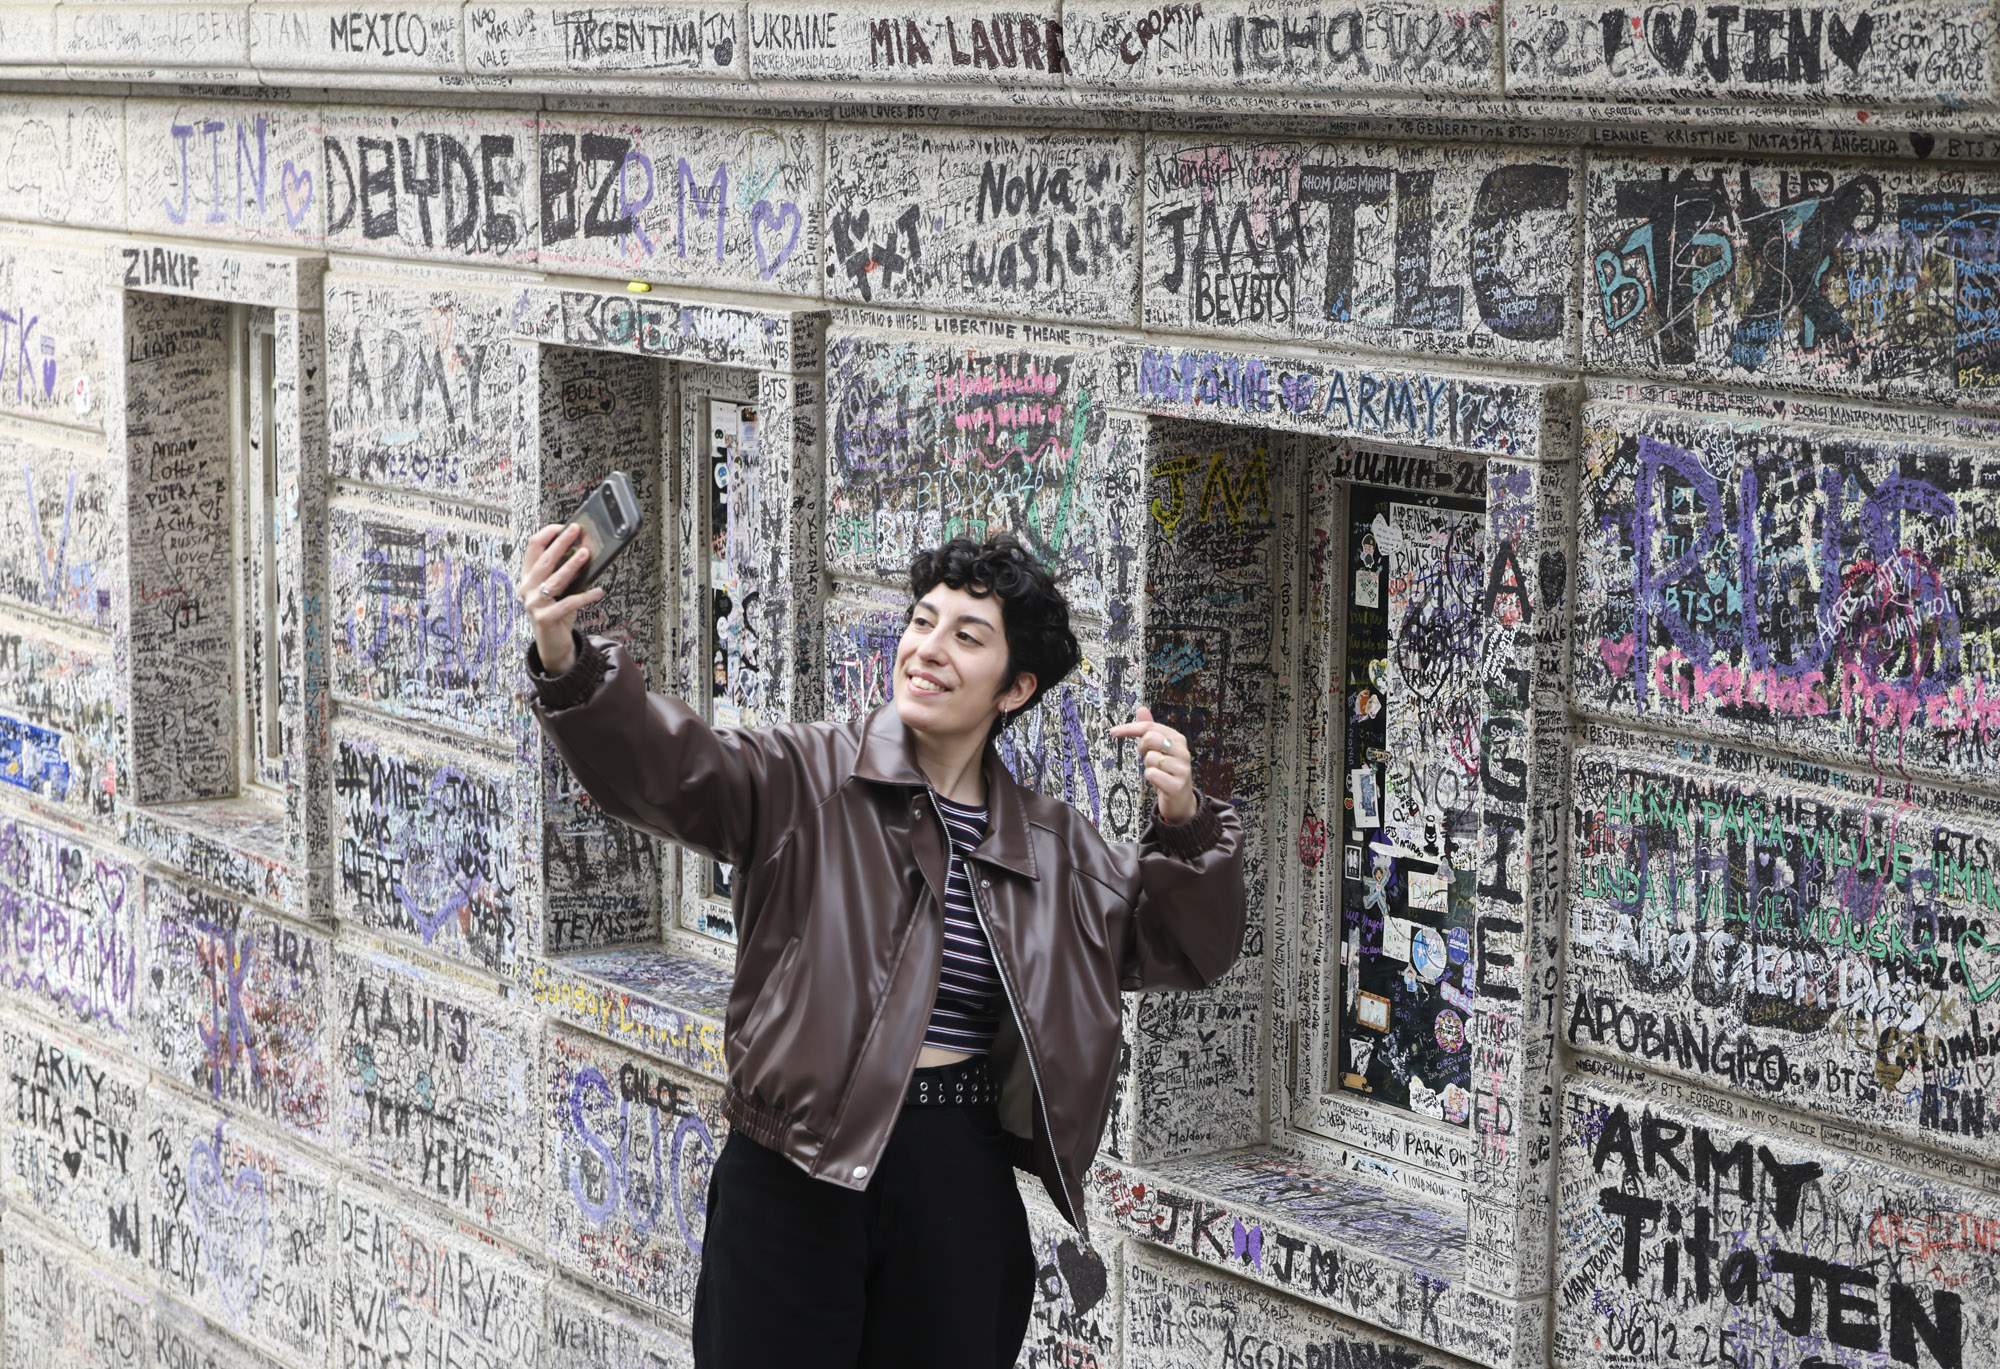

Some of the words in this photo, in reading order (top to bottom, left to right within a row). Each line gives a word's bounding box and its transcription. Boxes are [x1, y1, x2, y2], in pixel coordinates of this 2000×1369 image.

[330, 12, 427, 57] MEXICO
[571, 19, 700, 61] ARGENTINA
[704, 12, 737, 49] JM
[750, 13, 838, 50] UKRAINE
[870, 17, 933, 68] MIA
[1701, 4, 1823, 84] JIN
[1942, 20, 1984, 51] BTS
[1925, 50, 1985, 88] Grace
[839, 105, 869, 119] LUANA
[1666, 129, 1738, 145] KRISTINE
[1749, 131, 1823, 152] NATASHA
[1831, 134, 1899, 155] ANGELIKA
[1949, 138, 1985, 158] BTS
[164, 117, 269, 225] JIN
[620, 152, 727, 260] RM
[934, 317, 1018, 339] LIBERTINE
[762, 379, 788, 399] BTS
[1325, 370, 1449, 439] ARMY
[917, 471, 967, 509] BTS
[1151, 446, 1270, 545] JM
[1665, 586, 1714, 622] BTS
[1924, 588, 1964, 618] 2019
[34, 1043, 105, 1116] ARMY
[1660, 1082, 1682, 1100] BTS
[73, 1105, 128, 1174] JEN
[1404, 1132, 1445, 1159] PARK
[1592, 1104, 1825, 1232] ARMY
[341, 1199, 399, 1271] DEAR
[1150, 1188, 1228, 1259] JK
[1769, 1248, 1964, 1369] JEN
